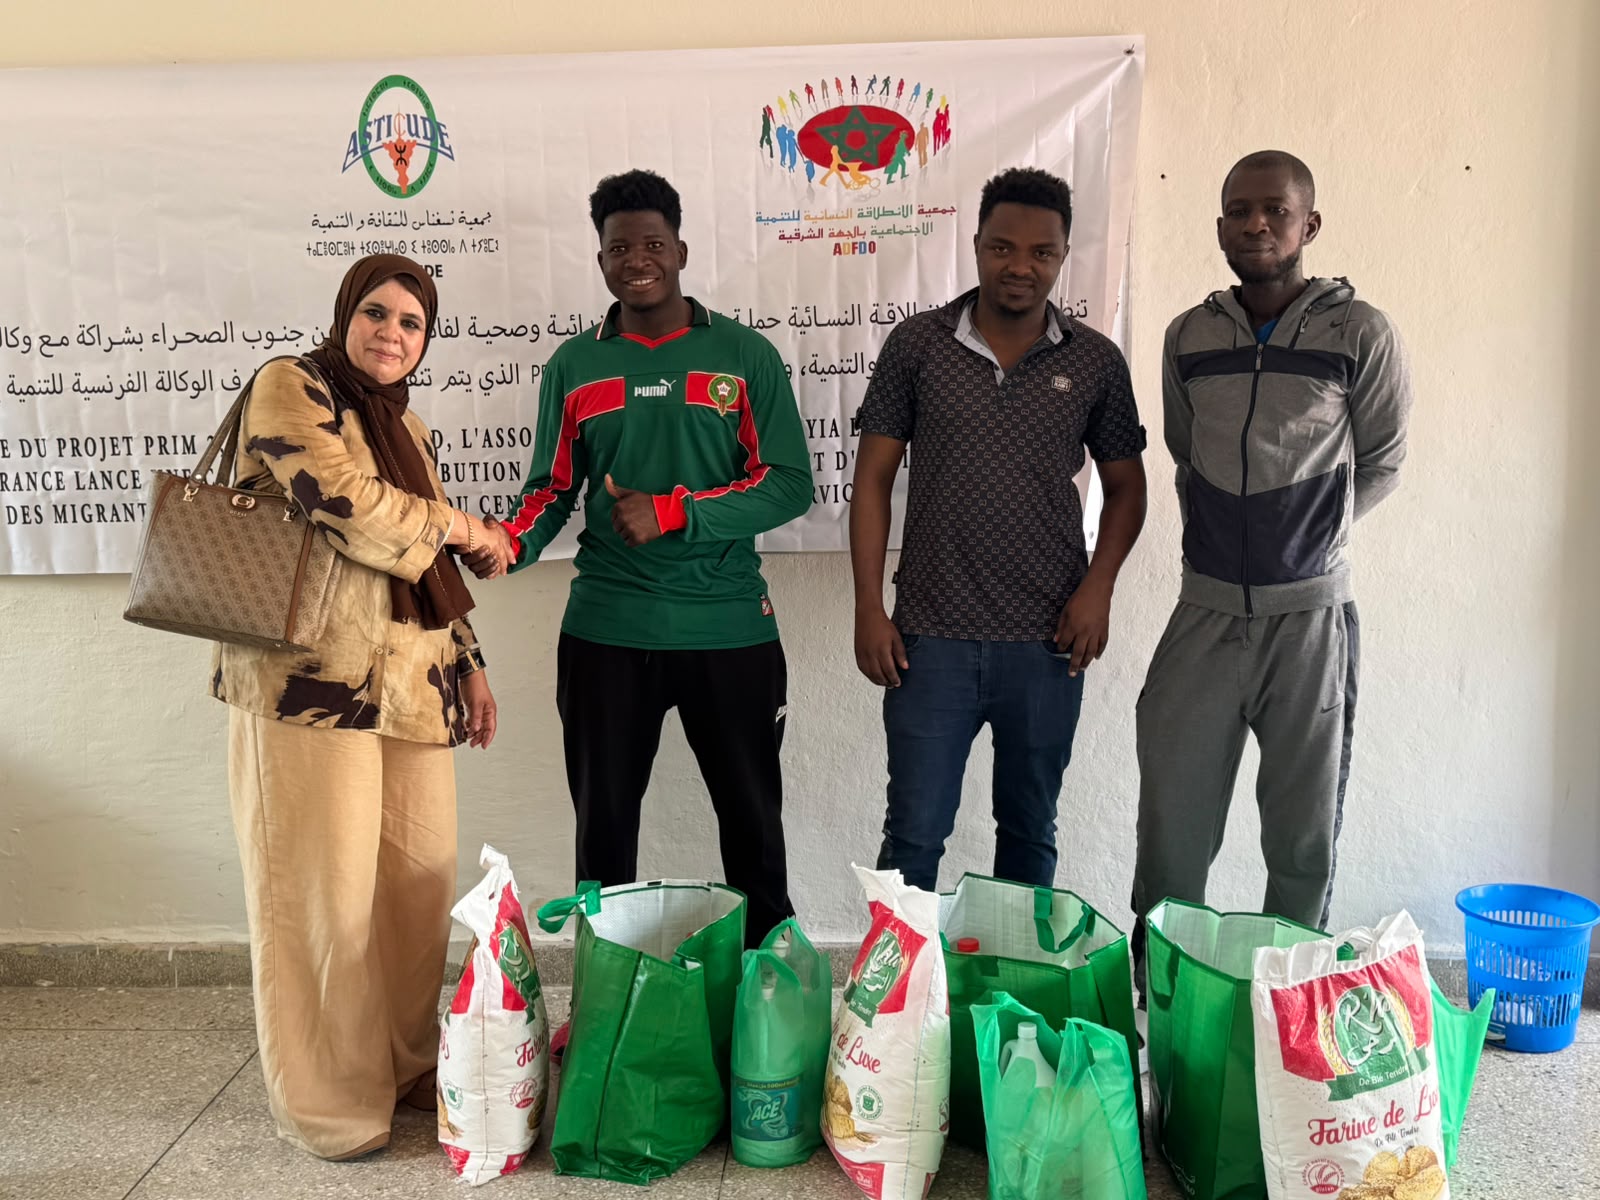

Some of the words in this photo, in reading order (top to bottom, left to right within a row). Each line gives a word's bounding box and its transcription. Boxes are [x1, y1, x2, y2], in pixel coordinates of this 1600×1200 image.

[342, 112, 455, 173] ASTICUDE
[311, 211, 354, 233] التنمية
[368, 210, 408, 228] للثقافة
[459, 211, 492, 231] جمعية
[755, 210, 801, 226] للتنمية
[857, 204, 913, 221] الانطلاقة
[917, 205, 957, 219] جمعية
[356, 219, 365, 231] و
[778, 228, 824, 244] الشرقية
[828, 225, 867, 241] بالجهة
[870, 222, 934, 239] الاجتماعية
[833, 241, 877, 256] ADFDO
[468, 316, 540, 345] وصحية
[788, 303, 862, 335] النسائية
[39, 334, 70, 358] مع
[76, 323, 144, 353] بشراكة
[151, 320, 235, 351] الصحراء
[242, 325, 305, 350] جنوب
[7, 372, 64, 403] للتنمية
[72, 370, 148, 401] الفرنسية
[155, 369, 214, 399] الوكالة
[440, 370, 472, 393] يتم
[478, 362, 520, 397] الذي
[634, 385, 667, 397] PUMA
[19, 438, 47, 458] DU
[56, 436, 134, 462] PROJET
[144, 435, 198, 456] PRIM
[461, 427, 532, 449] L'ASSO
[0, 470, 66, 492] RANCE
[75, 469, 142, 491] LANCE
[440, 461, 521, 483] BUTION
[6, 504, 44, 525] DES
[53, 503, 147, 525] MIGRANT
[845, 1036, 881, 1073] Luxe
[751, 1101, 781, 1121] ACE
[1307, 1116, 1378, 1146] Farine
[1383, 1099, 1406, 1128] de
